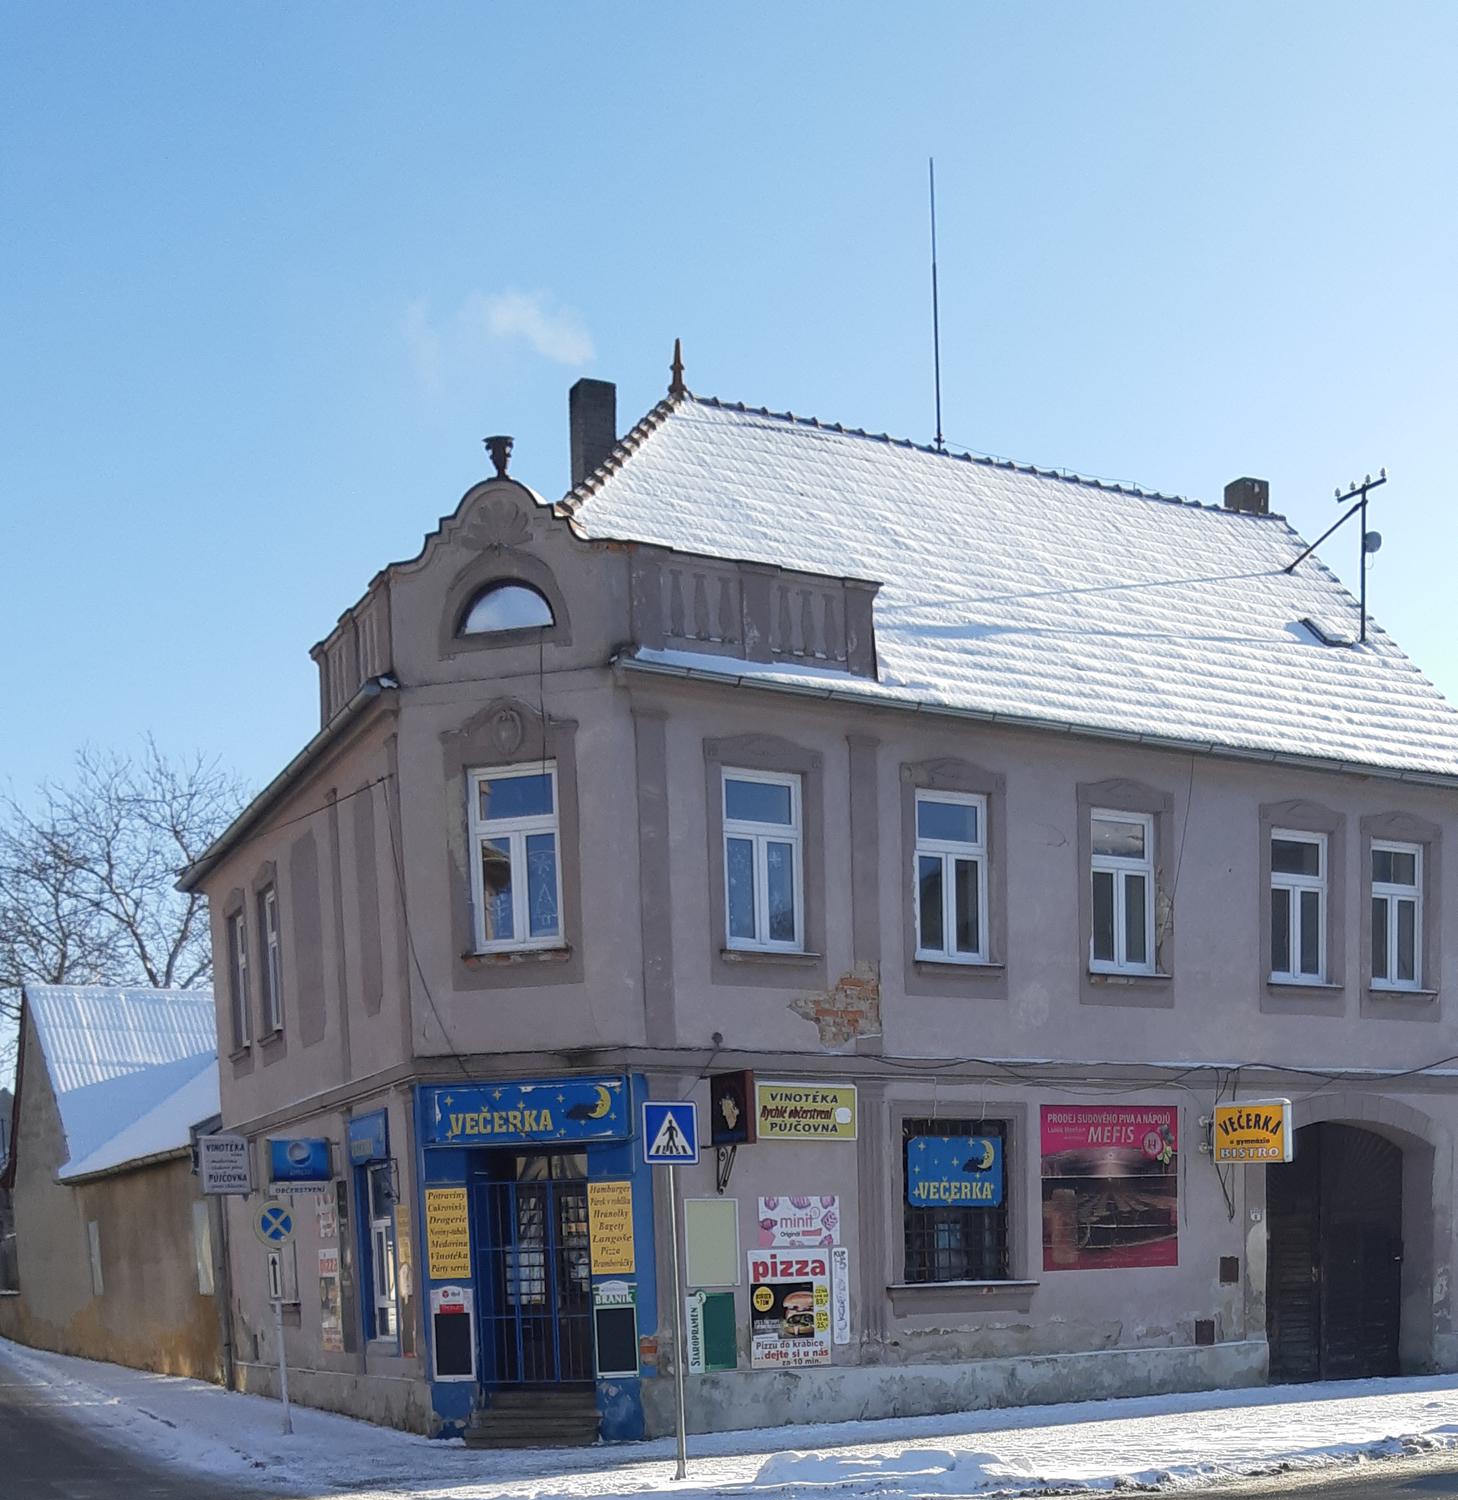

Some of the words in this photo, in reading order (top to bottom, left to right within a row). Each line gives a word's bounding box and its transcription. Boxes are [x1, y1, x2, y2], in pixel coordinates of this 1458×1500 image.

[770, 1091, 838, 1104] VINOTÉKA
[760, 1105, 788, 1121] Rychlé
[788, 1105, 834, 1120] občerstvení
[1047, 1113, 1076, 1124] PRODEJ
[1077, 1111, 1117, 1124] SUDOVÉHO
[1119, 1113, 1135, 1124] PIVA
[1136, 1114, 1142, 1124] A
[1143, 1112, 1170, 1125] NÁPOJŮ
[449, 1106, 553, 1135] VEČERKA
[770, 1120, 838, 1133] PŮJČOVNA
[1218, 1109, 1282, 1136] VEČERKA
[1087, 1126, 1135, 1143] MEFIS
[1220, 1147, 1279, 1159] BISTRO
[590, 1185, 630, 1194] Hamburger
[918, 1177, 992, 1200] VEČERKA
[428, 1192, 465, 1201] Potraviny
[593, 1209, 628, 1219] Hranolky
[429, 1216, 467, 1225] Drogerie
[780, 1213, 813, 1228] minit
[599, 1222, 624, 1232] Bagety
[592, 1234, 632, 1244] Langoše
[431, 1252, 468, 1260] Vinotéka
[600, 1247, 620, 1255] Pizza
[752, 1254, 826, 1283] pizza
[691, 1306, 700, 1366] STAROPRAMEN
[756, 1341, 778, 1350] Pizzu
[780, 1340, 790, 1348] do
[793, 1340, 824, 1348] krabice
[792, 1349, 800, 1357] si
[812, 1348, 829, 1357] nás
